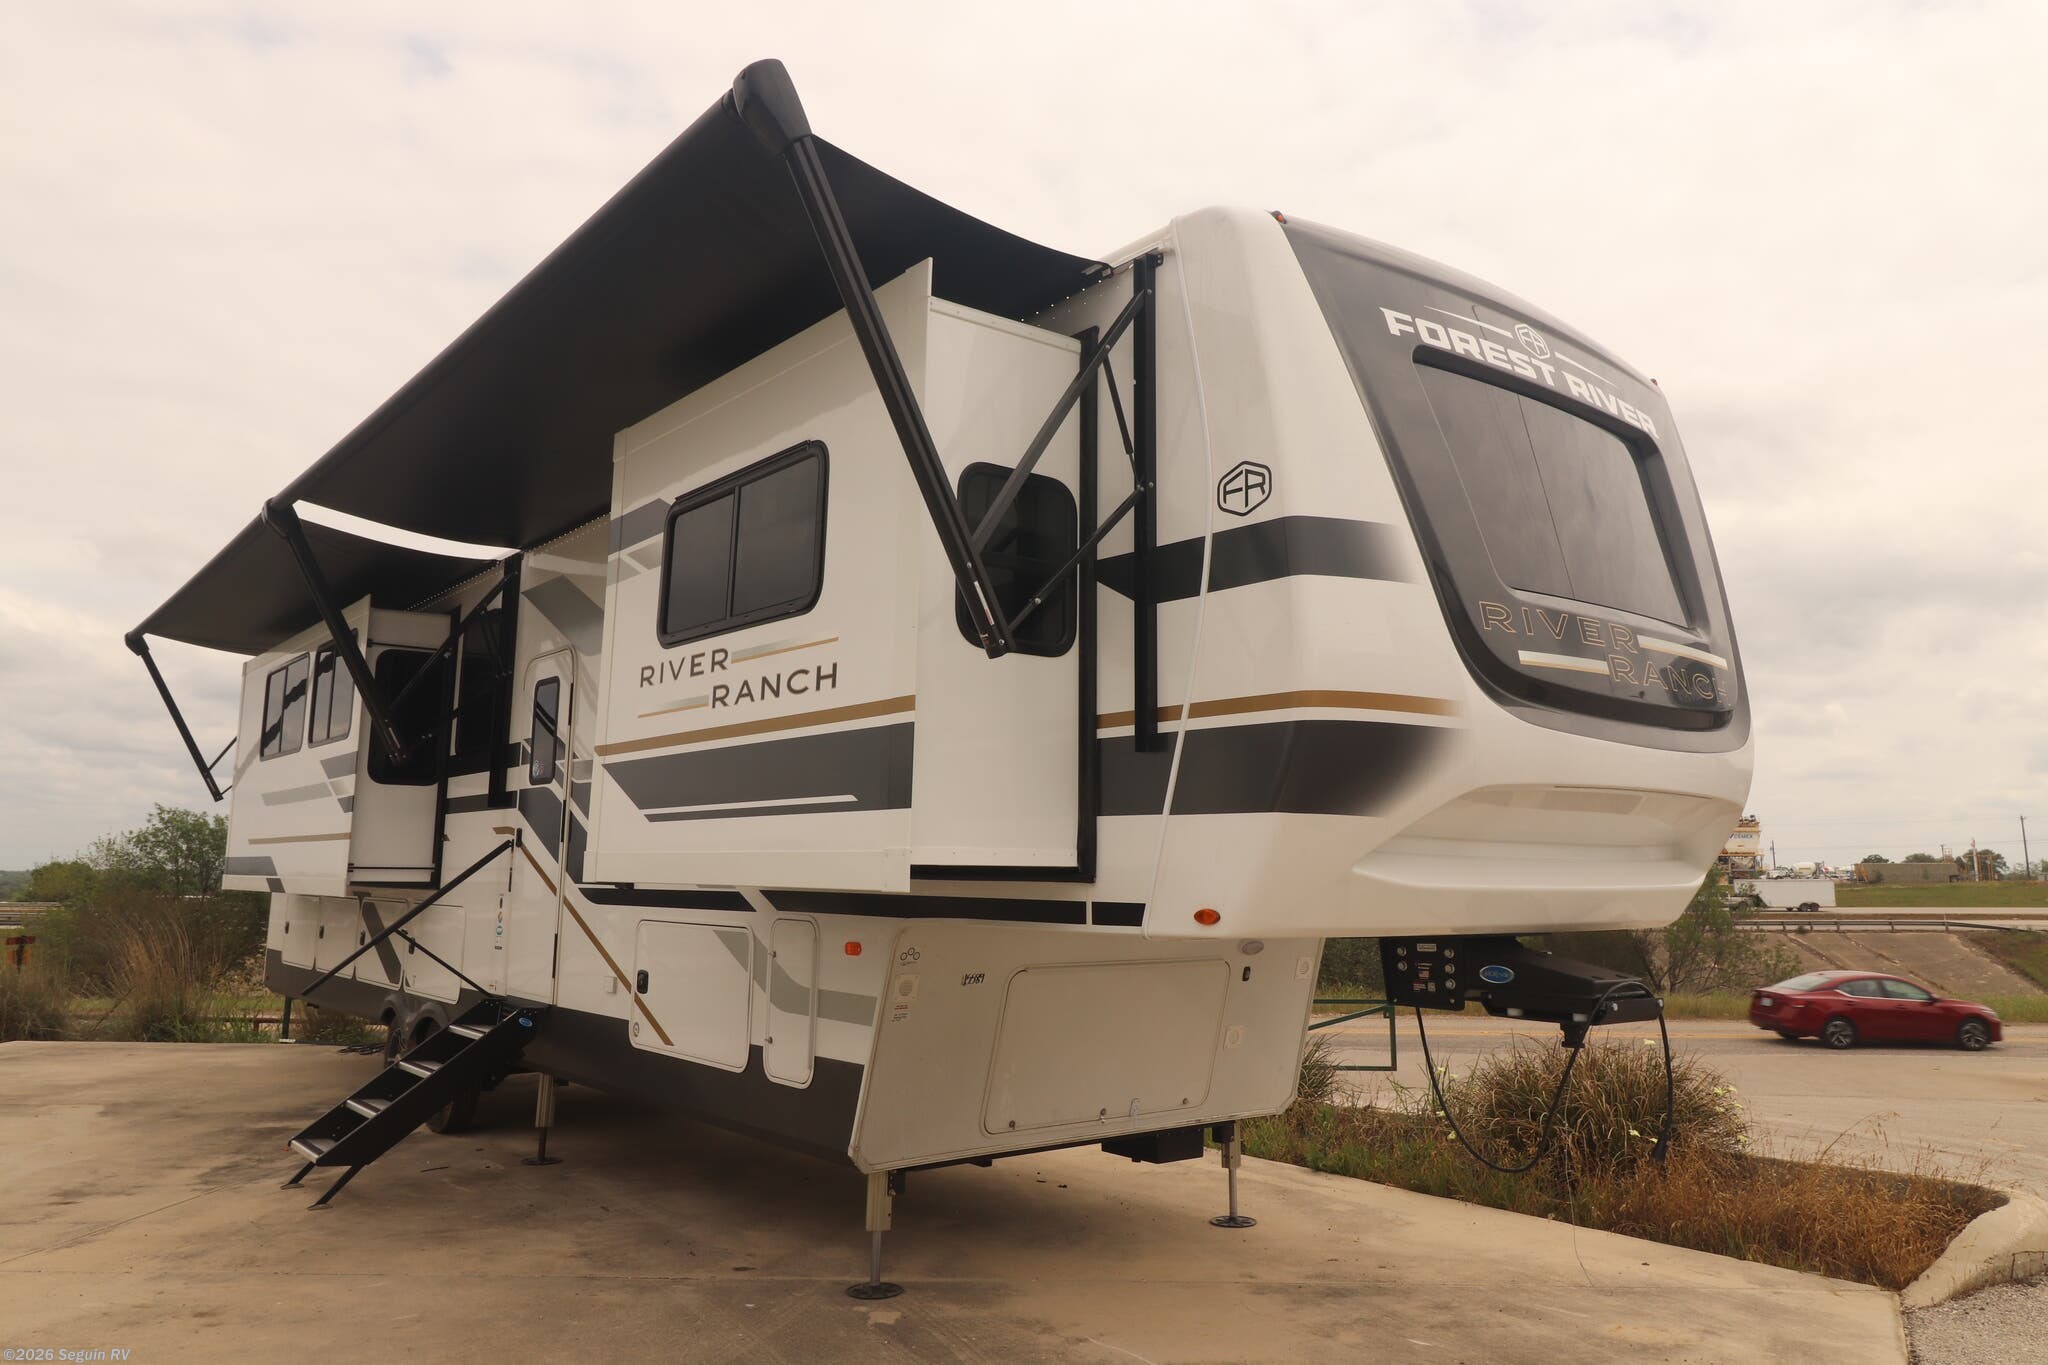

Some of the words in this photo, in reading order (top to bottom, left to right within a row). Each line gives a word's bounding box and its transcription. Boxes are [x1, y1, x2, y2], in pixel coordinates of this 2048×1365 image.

[1379, 307, 1554, 386] FOREST
[1562, 371, 1659, 438] RIVER
[1478, 600, 1638, 655] RIVER
[640, 648, 729, 688] RIVER
[711, 662, 838, 709] RANCH
